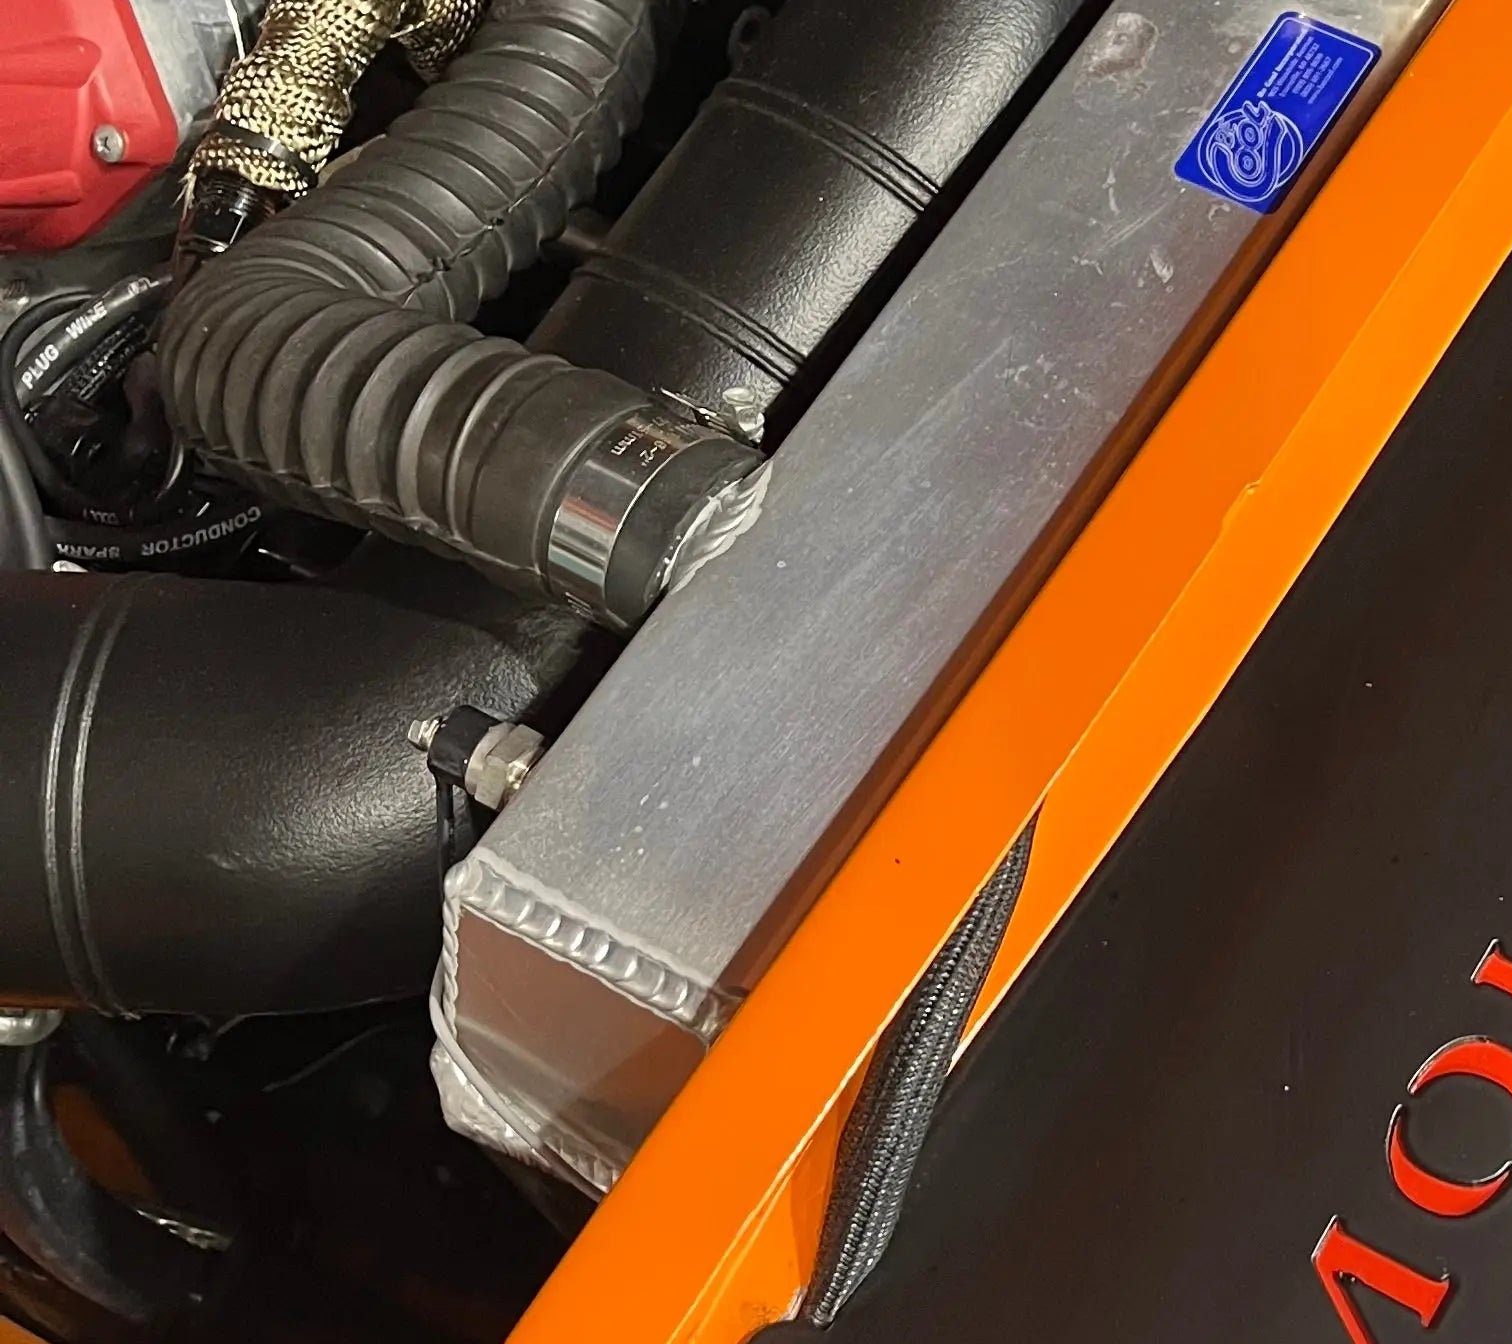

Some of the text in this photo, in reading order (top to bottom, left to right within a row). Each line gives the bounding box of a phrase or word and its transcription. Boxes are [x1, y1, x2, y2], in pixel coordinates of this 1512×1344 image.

[21, 343, 60, 390] PLUG
[56, 542, 121, 559] SPARK
[141, 505, 262, 555] CONDUCTOR
